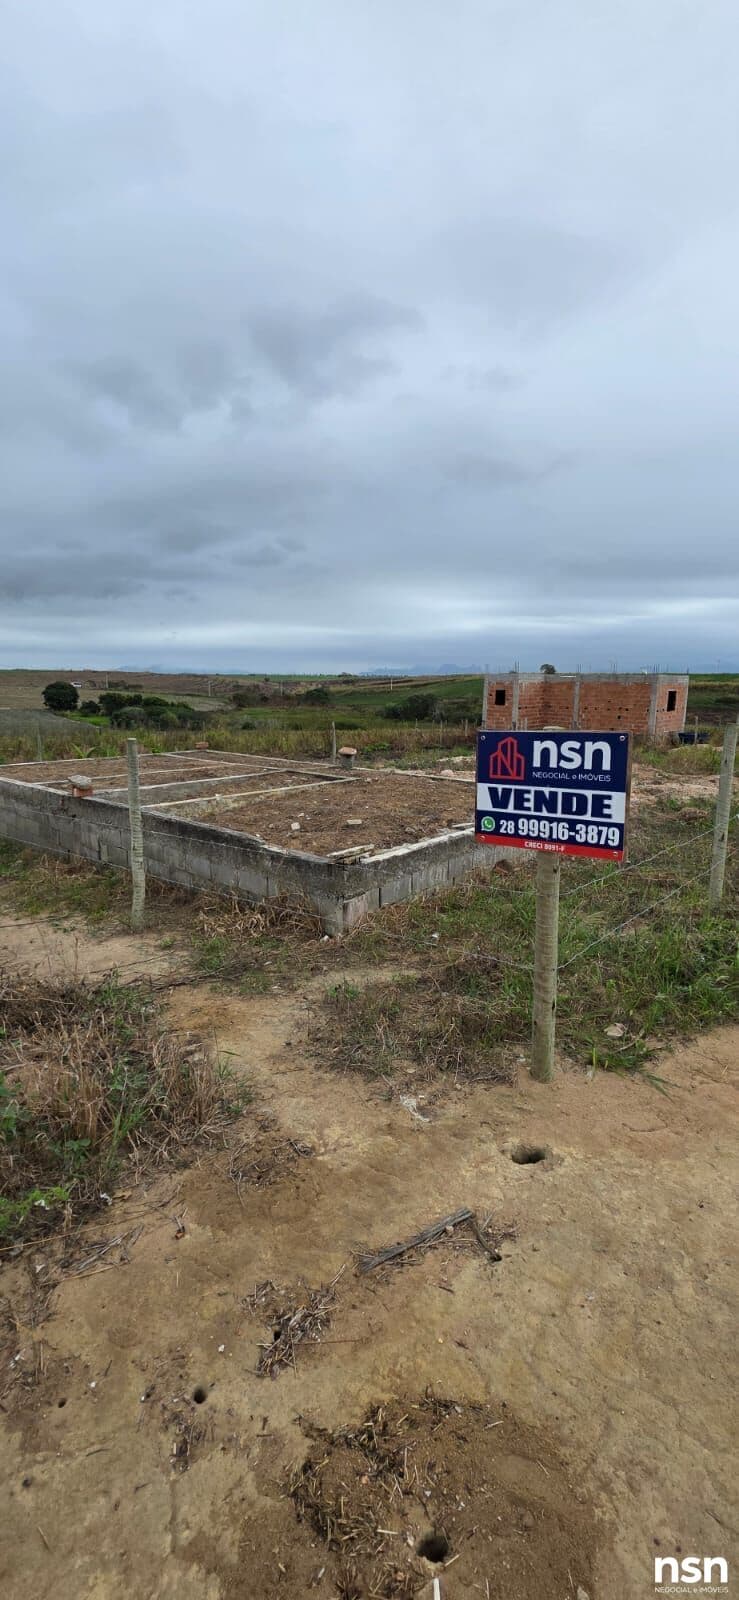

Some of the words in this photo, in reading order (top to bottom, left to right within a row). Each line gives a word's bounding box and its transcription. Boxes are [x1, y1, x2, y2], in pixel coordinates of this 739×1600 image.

[532, 740, 611, 770] nsn
[532, 771, 570, 780] NEGOCIAL
[578, 772, 611, 782] IMÓVEIS
[488, 787, 612, 819] VENDE
[499, 820, 514, 834] 28
[518, 818, 620, 846] 99916-3879
